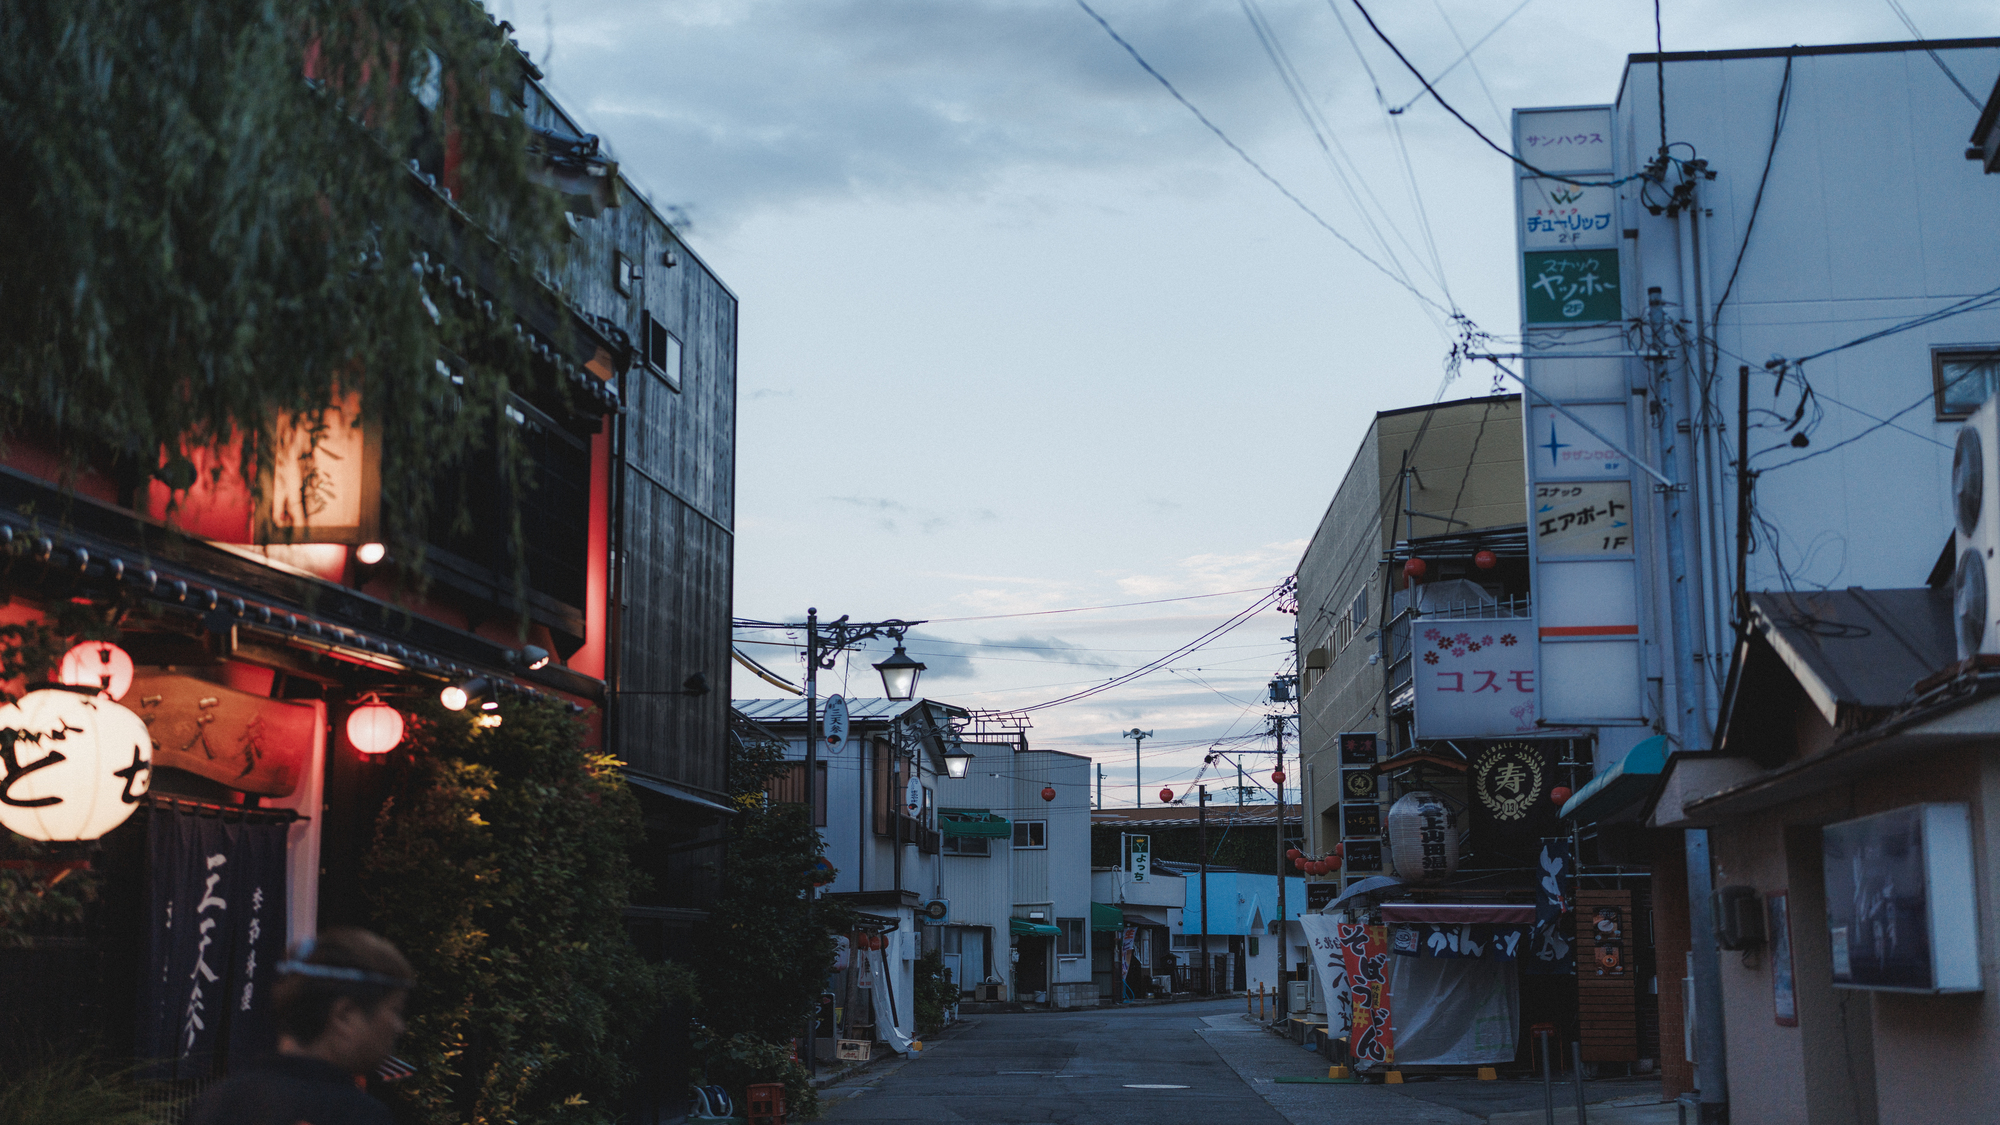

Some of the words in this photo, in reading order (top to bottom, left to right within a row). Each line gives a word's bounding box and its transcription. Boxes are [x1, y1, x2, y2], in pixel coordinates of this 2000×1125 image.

[1526, 132, 1604, 148] サンハウス
[1527, 213, 1611, 233] チューリップ
[1543, 258, 1600, 272] スナック
[1532, 272, 1617, 301] ヤッホー
[1537, 487, 1582, 497] スナック
[1539, 500, 1625, 536] エアポート
[1602, 537, 1628, 550] 1F
[1473, 742, 1513, 770] BASEBALL
[1519, 742, 1546, 767] TAVERN
[1494, 762, 1526, 794] 寿
[1506, 803, 1515, 813] 13
[1134, 854, 1147, 881] よっち
